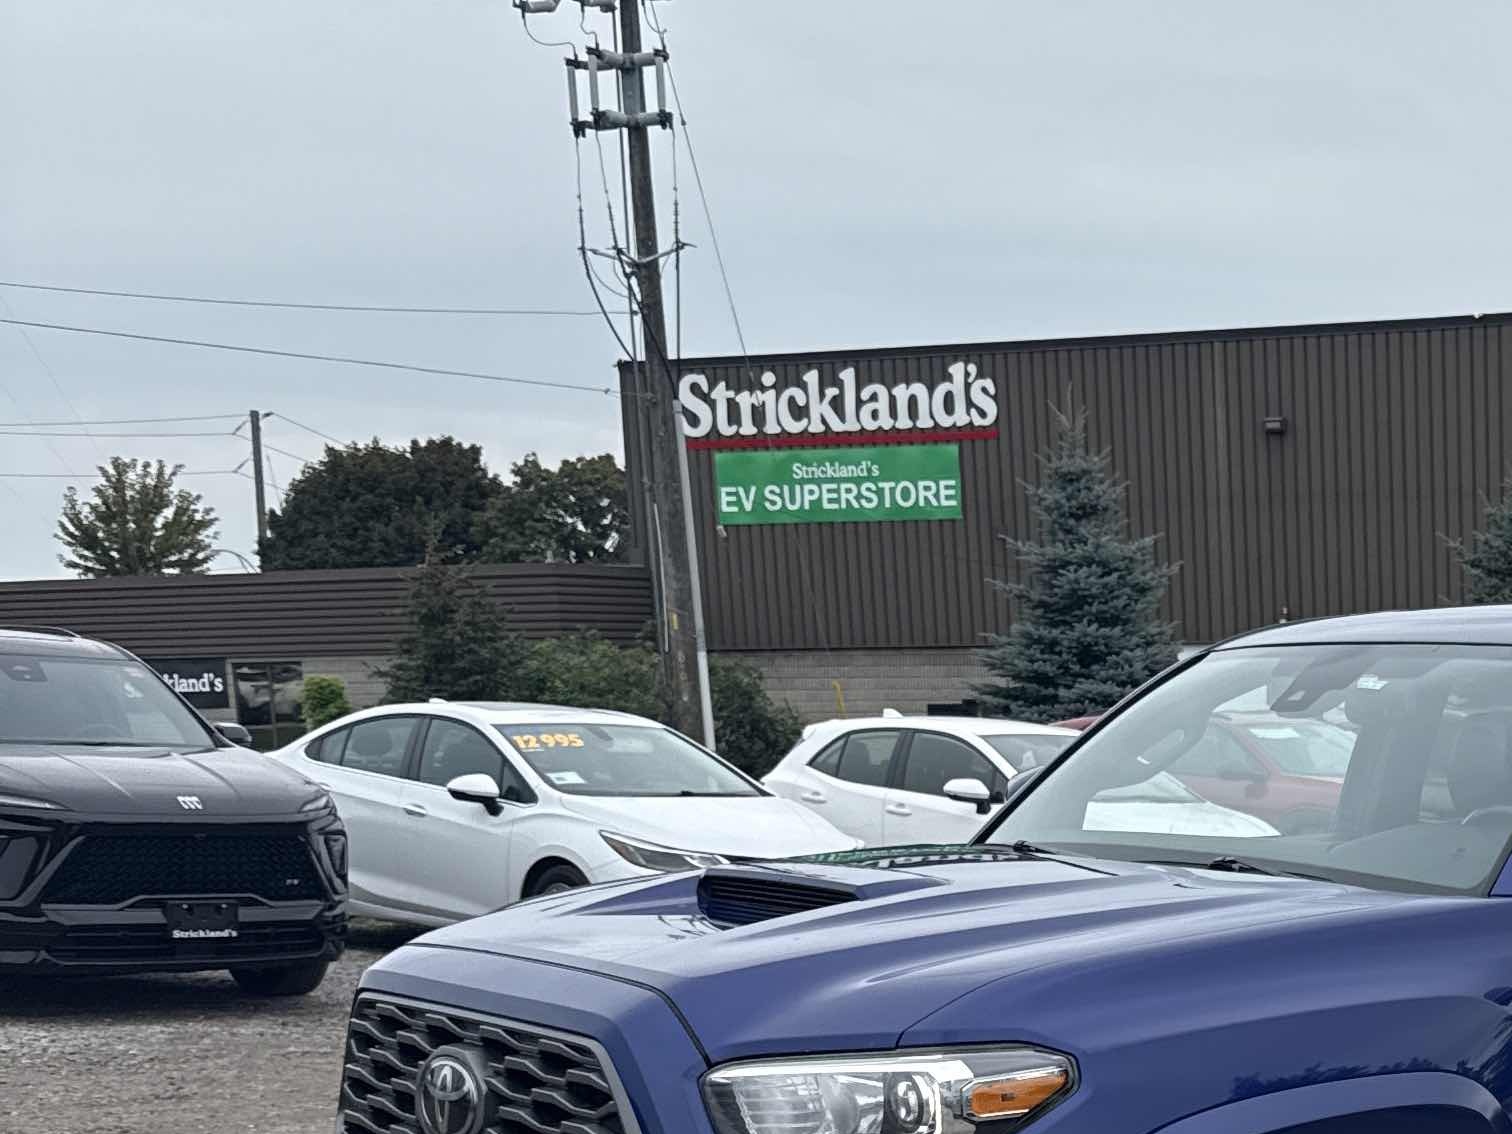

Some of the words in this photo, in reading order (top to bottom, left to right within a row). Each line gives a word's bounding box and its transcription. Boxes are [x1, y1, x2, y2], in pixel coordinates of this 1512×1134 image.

[678, 361, 998, 438] Strickland's
[792, 461, 880, 480] Strickland's
[720, 485, 757, 513] EV
[764, 480, 958, 512] SUPERSTORE
[172, 929, 238, 939] Strickland's
